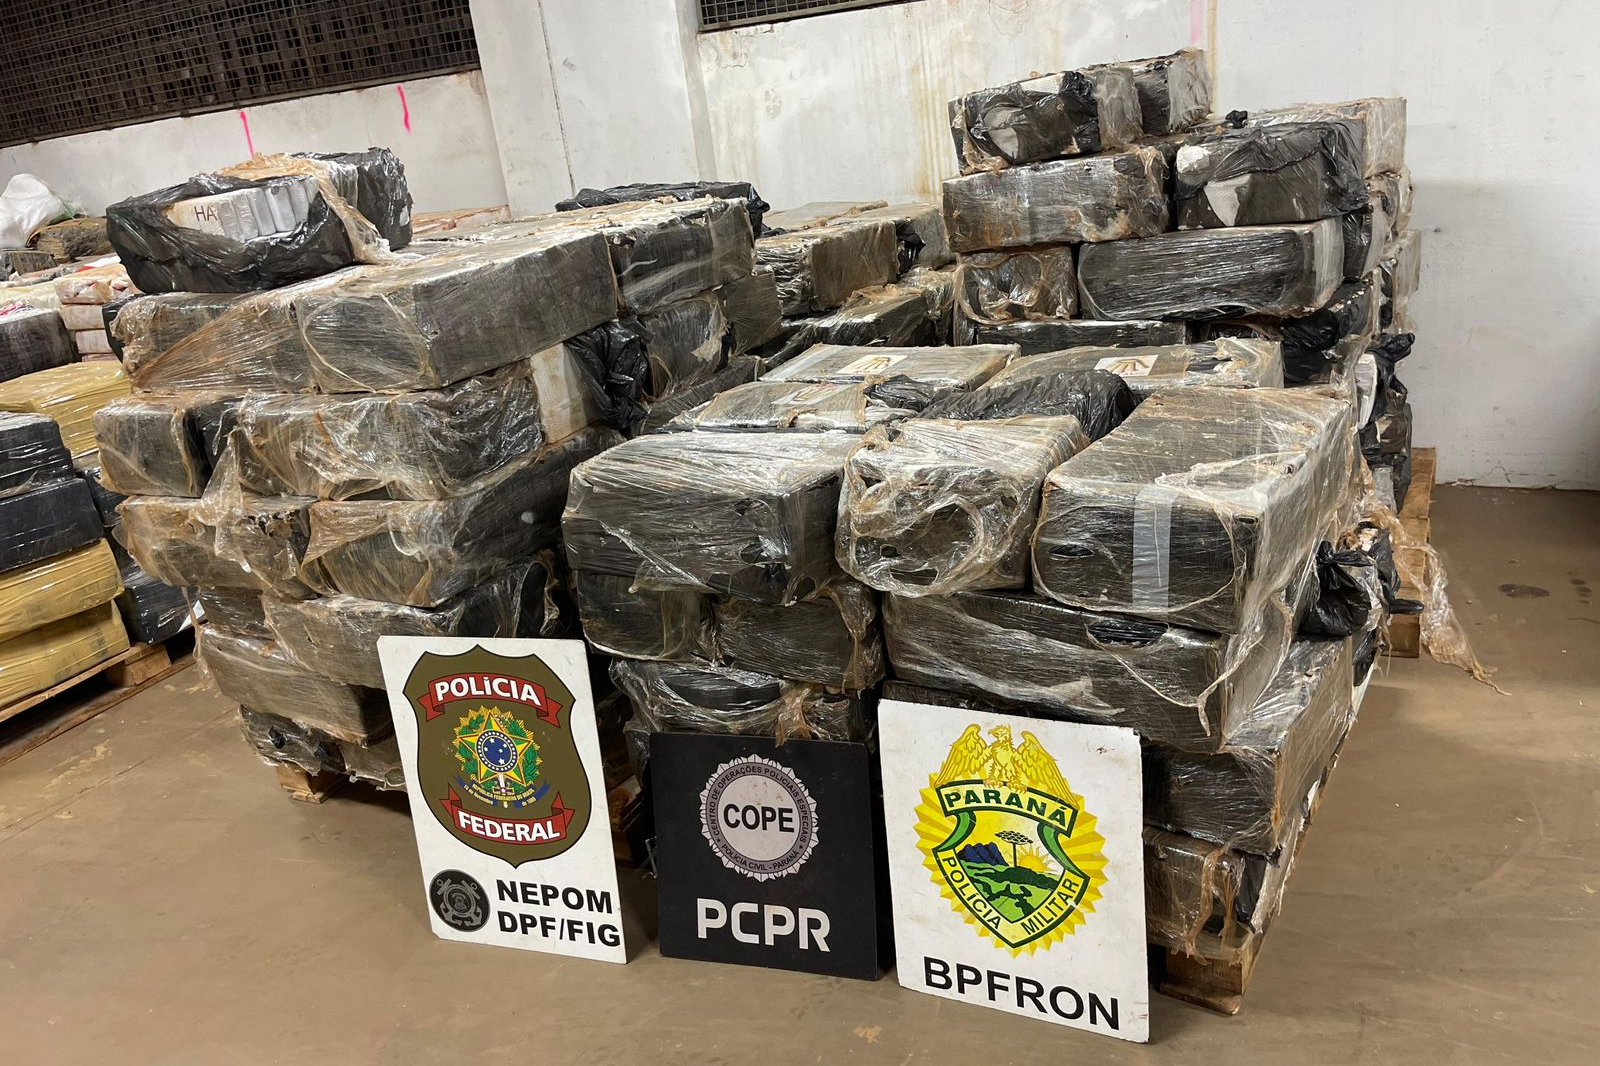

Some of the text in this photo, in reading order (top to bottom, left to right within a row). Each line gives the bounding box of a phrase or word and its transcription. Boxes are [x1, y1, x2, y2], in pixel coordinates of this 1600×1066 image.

[435, 676, 541, 706] POLÍCIA
[709, 765, 809, 843] CENTRO DE OPERAÇÕES POLICIAIS ESPECIAIS
[723, 803, 795, 833] COPE
[944, 788, 1067, 827] PARANÁ
[458, 810, 560, 842] FEDERAL
[748, 861, 768, 871] CIVIL
[496, 879, 613, 914] NEPOM
[942, 856, 1079, 936] POLÍCIA MILITAR
[497, 910, 621, 947] DPF/FIG
[697, 897, 831, 952] PCPR
[923, 956, 1120, 1031] BPFRON
